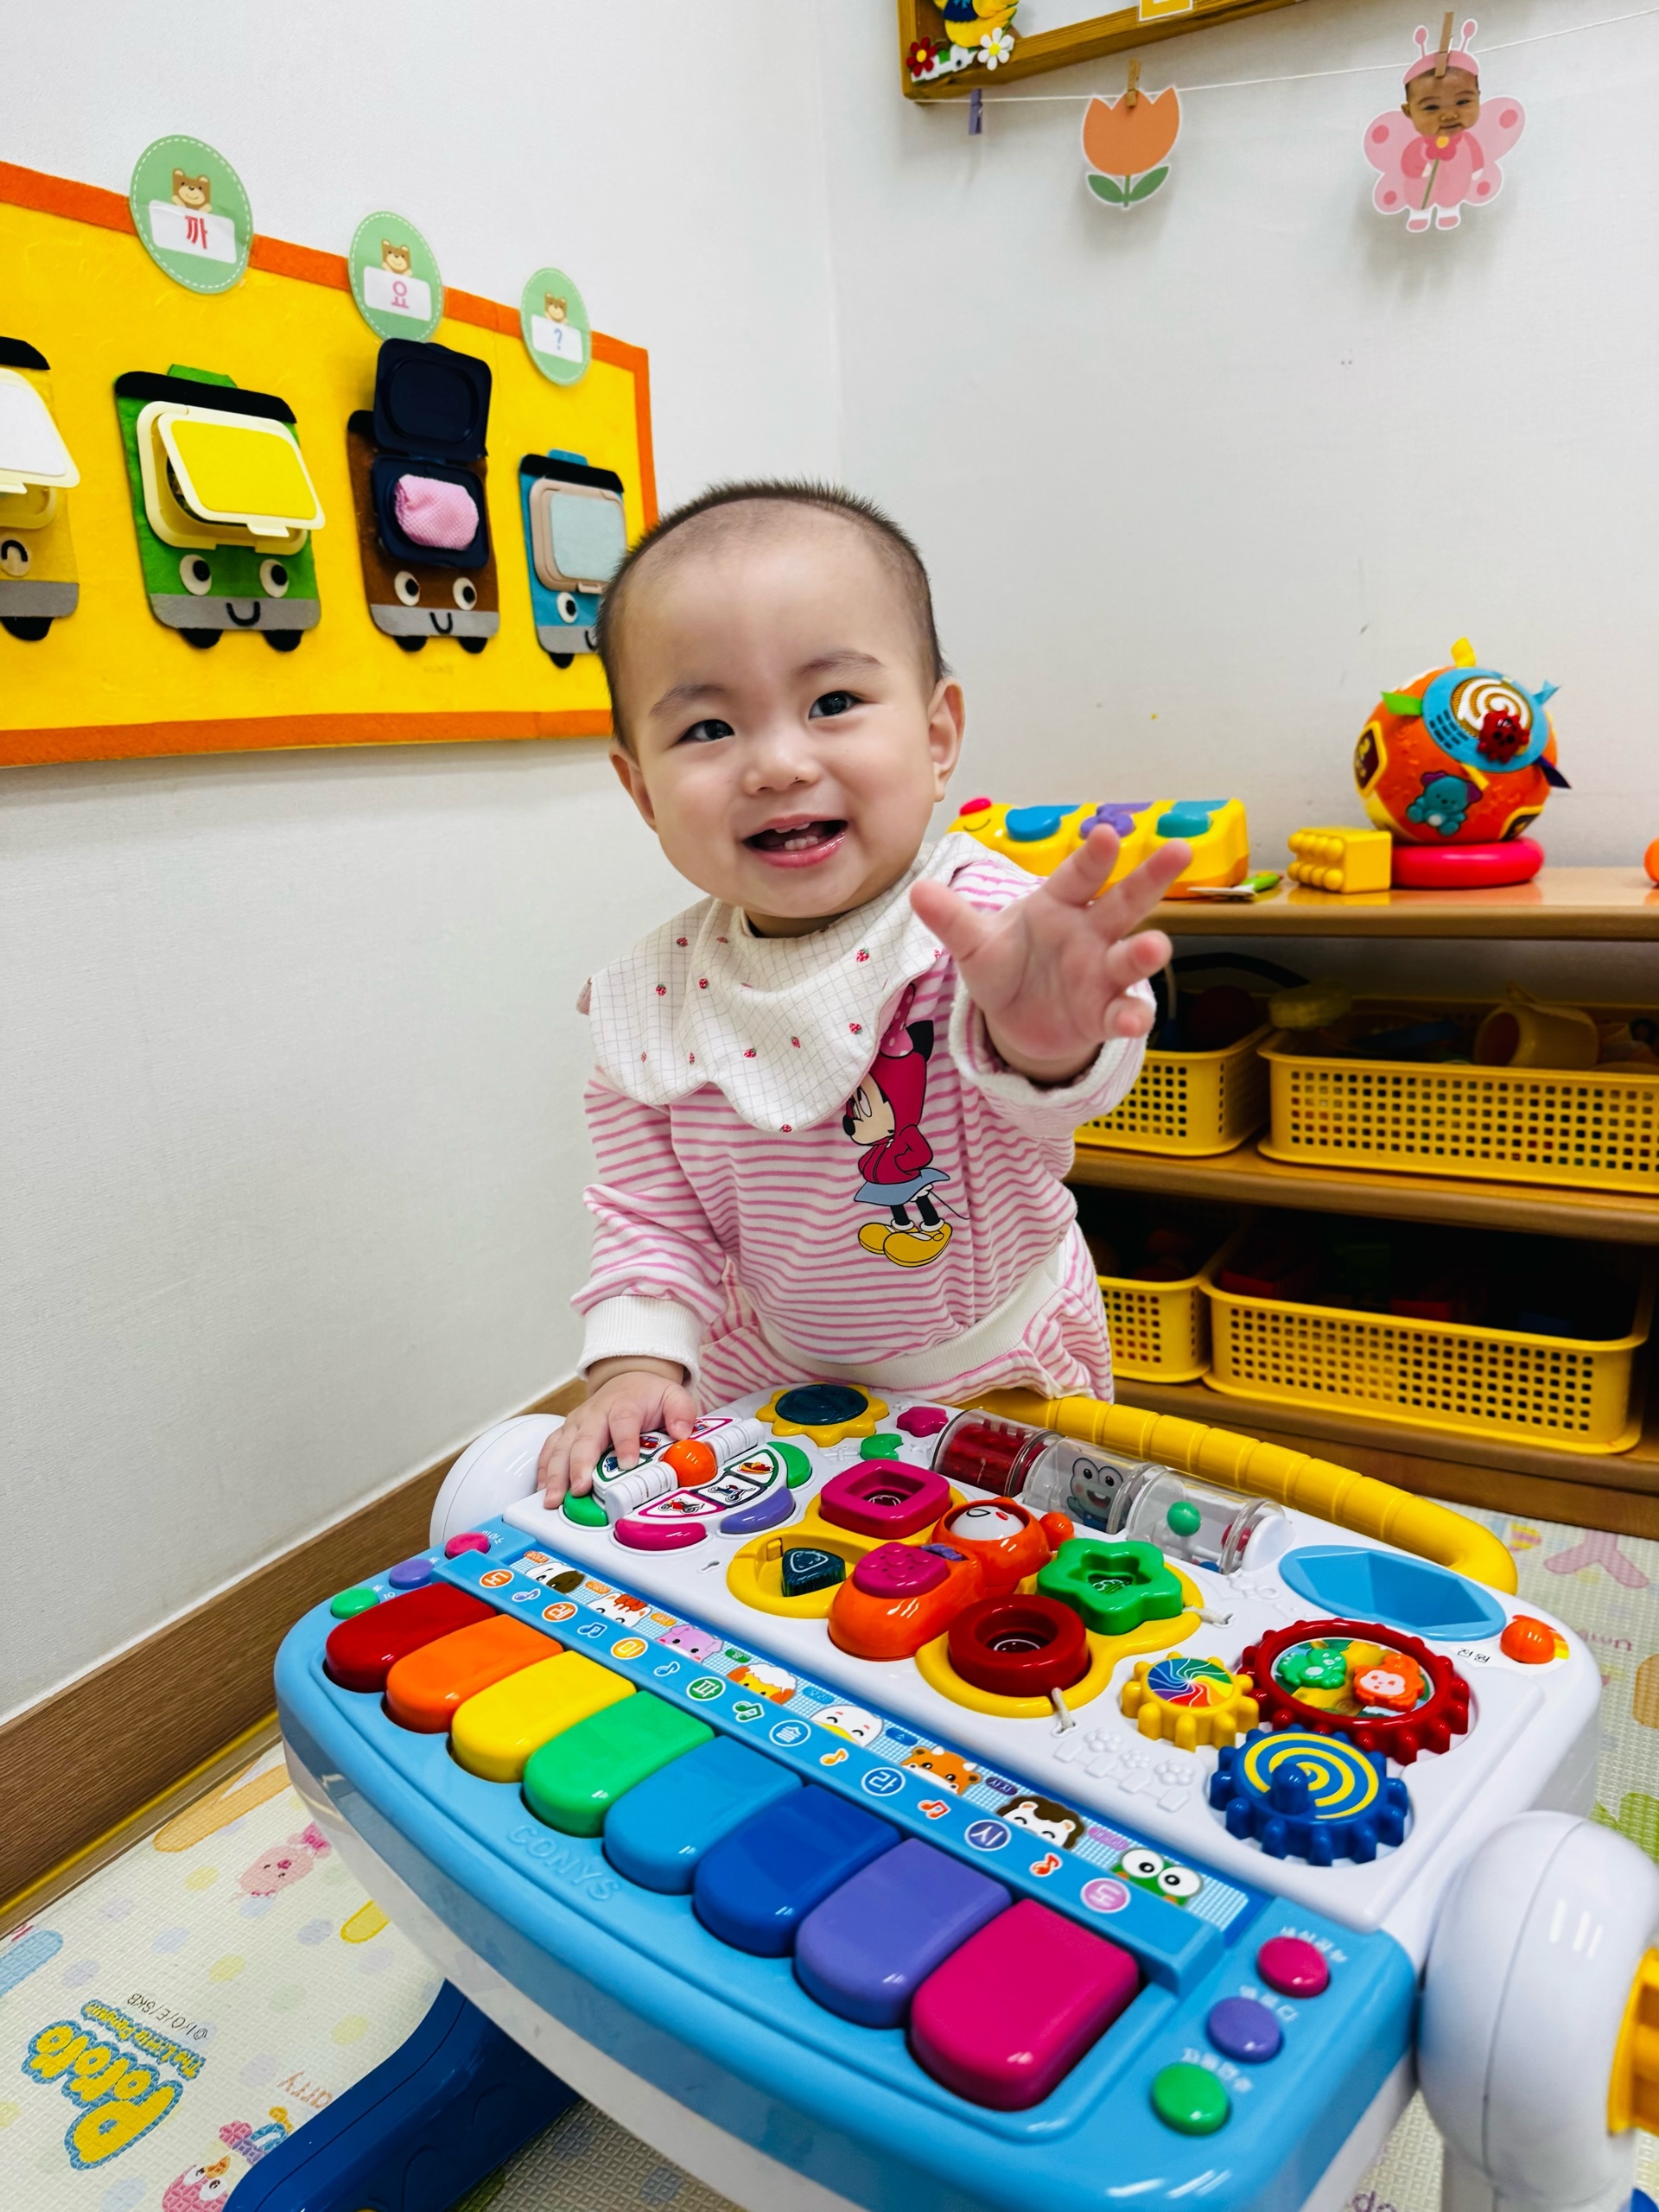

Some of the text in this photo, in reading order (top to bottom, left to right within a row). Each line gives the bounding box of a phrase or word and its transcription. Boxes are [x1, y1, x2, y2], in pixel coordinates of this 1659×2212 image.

[184, 215, 208, 250] 까
[391, 281, 410, 309] 요
[554, 327, 563, 351] ?
[1457, 1648, 1491, 1664] 전원
[485, 1571, 510, 1586] 도
[547, 1605, 575, 1620] 레
[618, 1641, 645, 1657] 미
[691, 1679, 720, 1698] 파
[868, 1770, 898, 1792] 라
[969, 1825, 1005, 1847] 시
[1088, 1883, 1122, 1909] 도
[987, 1778, 1014, 1793] 사자
[21, 2020, 183, 2171] Pororo
[276, 2070, 334, 2108] arry
